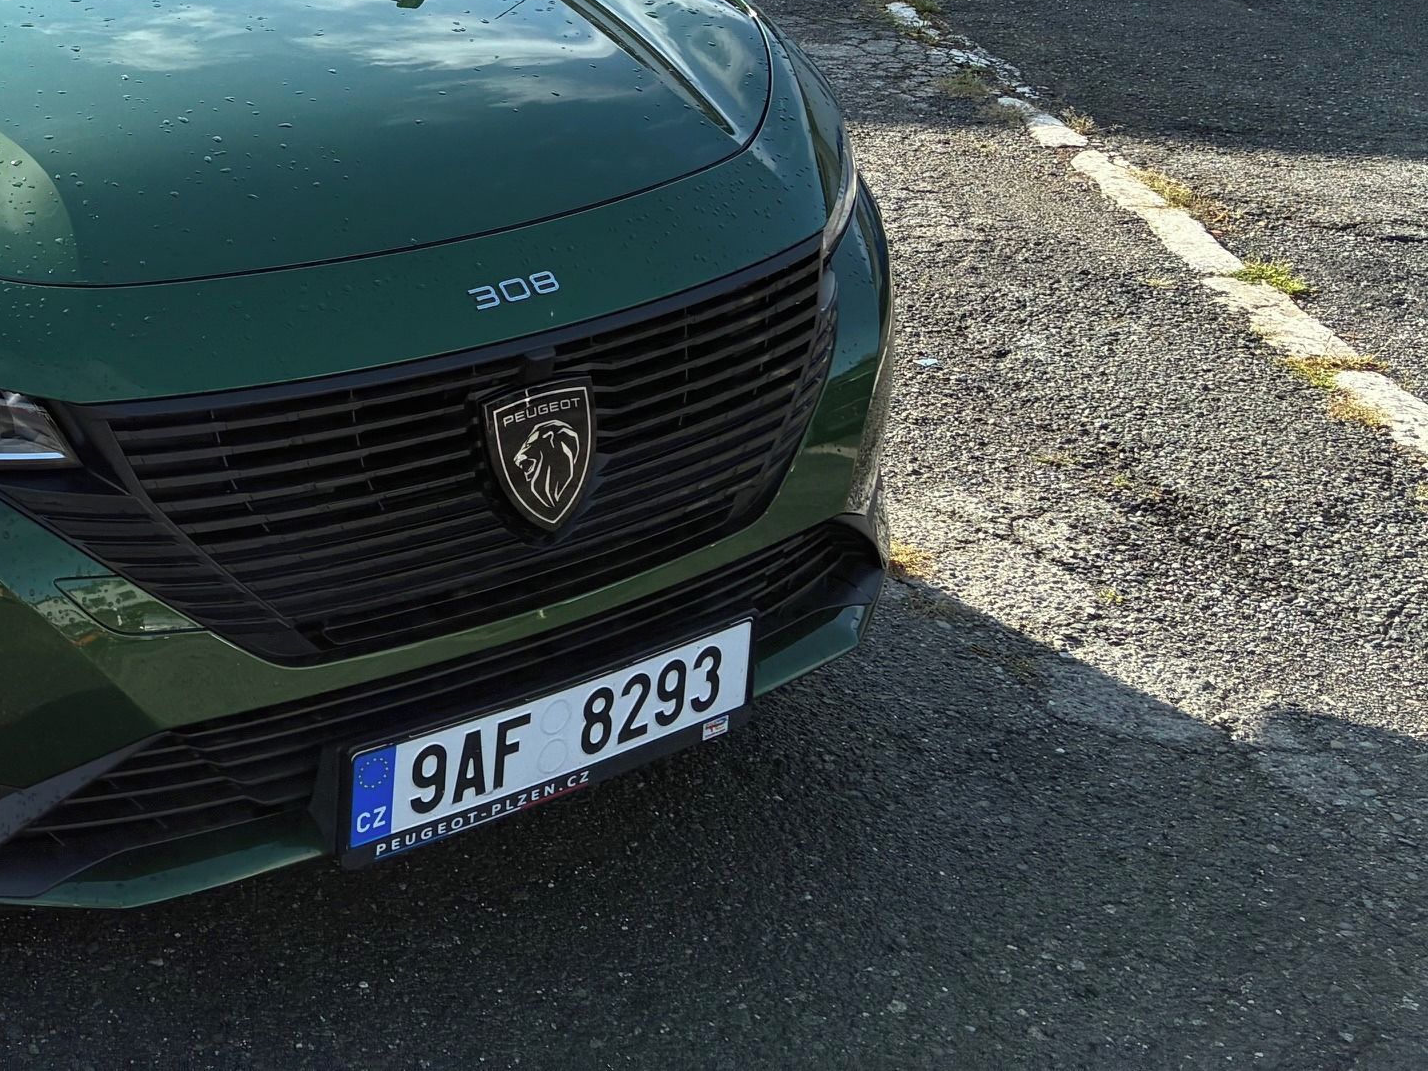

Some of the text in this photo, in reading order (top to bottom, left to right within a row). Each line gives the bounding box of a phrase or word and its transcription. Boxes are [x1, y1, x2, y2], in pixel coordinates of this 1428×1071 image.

[467, 270, 560, 311] 308
[502, 397, 581, 427] PEUGEOT
[409, 645, 723, 815] 9AF 8293
[356, 805, 387, 834] CZ
